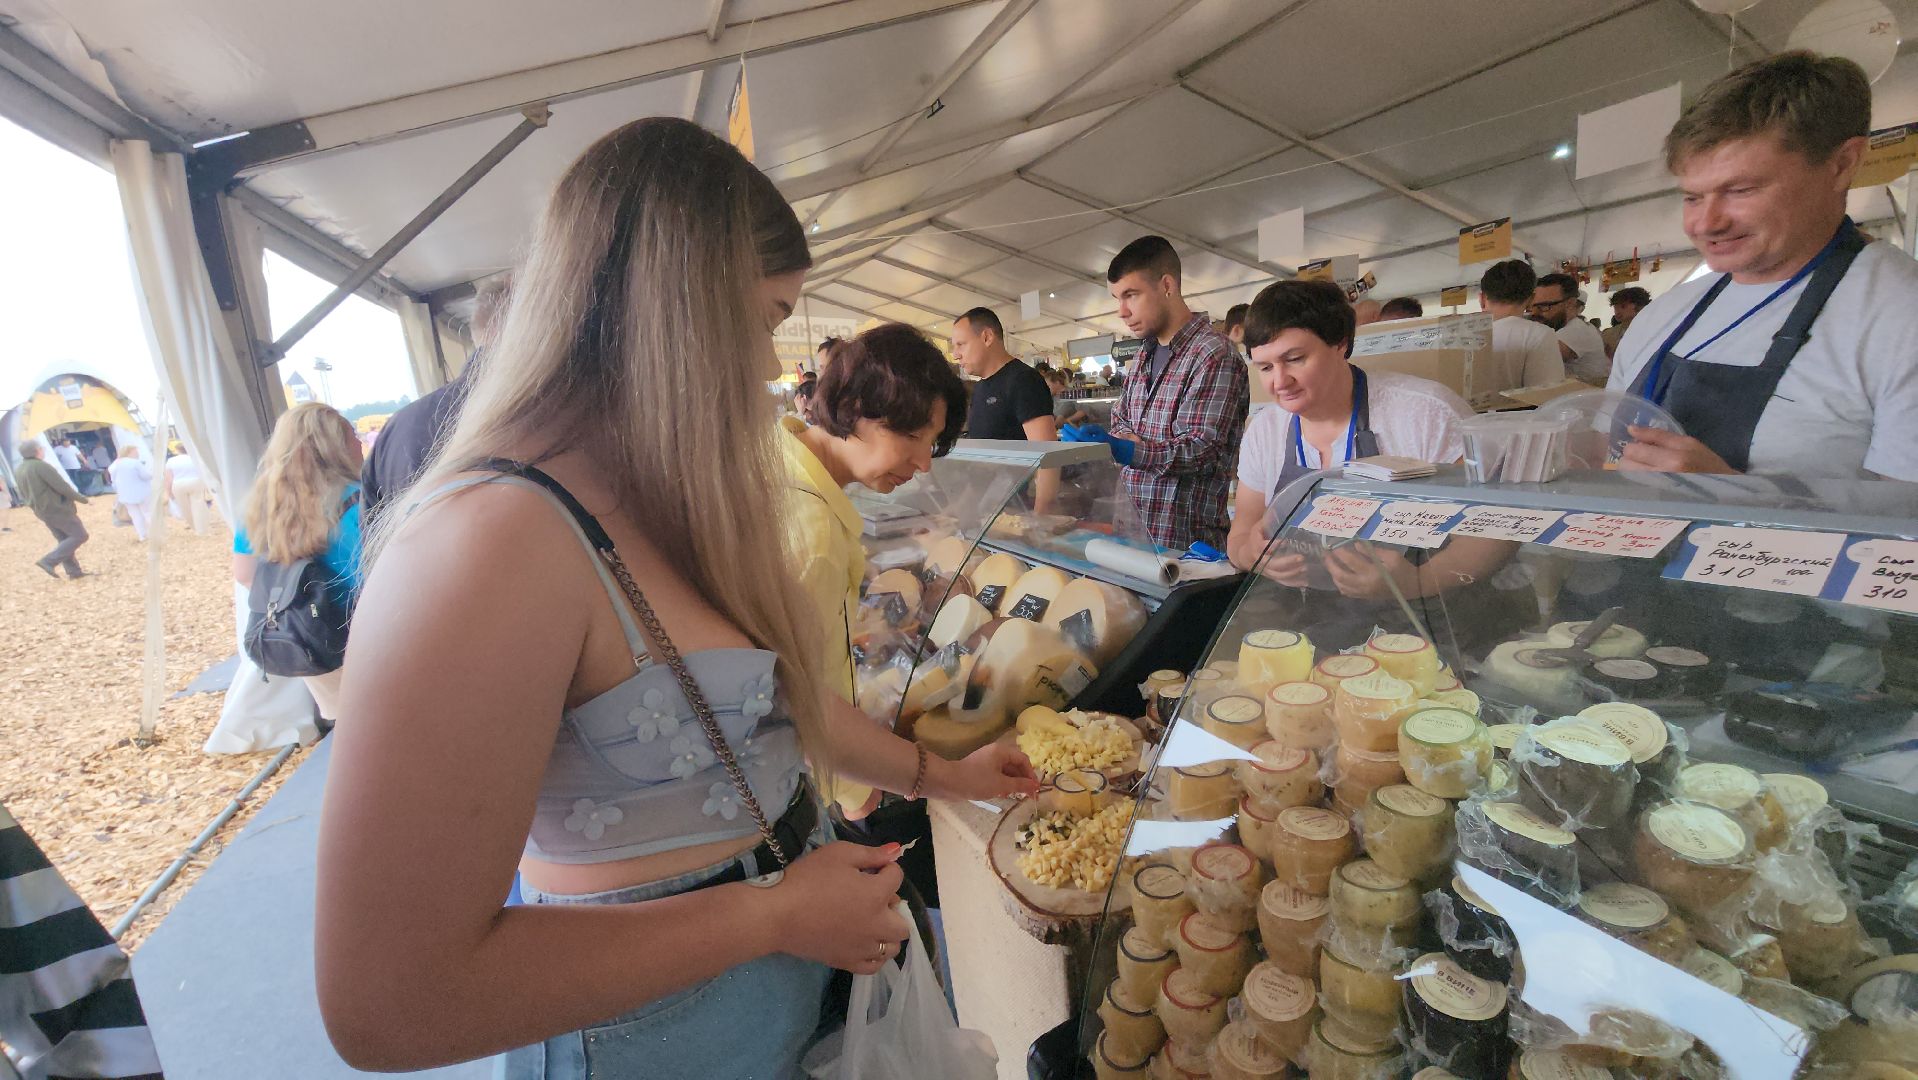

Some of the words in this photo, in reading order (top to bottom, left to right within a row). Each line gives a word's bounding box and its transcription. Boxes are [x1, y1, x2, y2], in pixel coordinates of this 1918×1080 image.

[1380, 527, 1408, 538] 350
[1698, 564, 1755, 579] 310
[1863, 585, 1908, 599] 310
